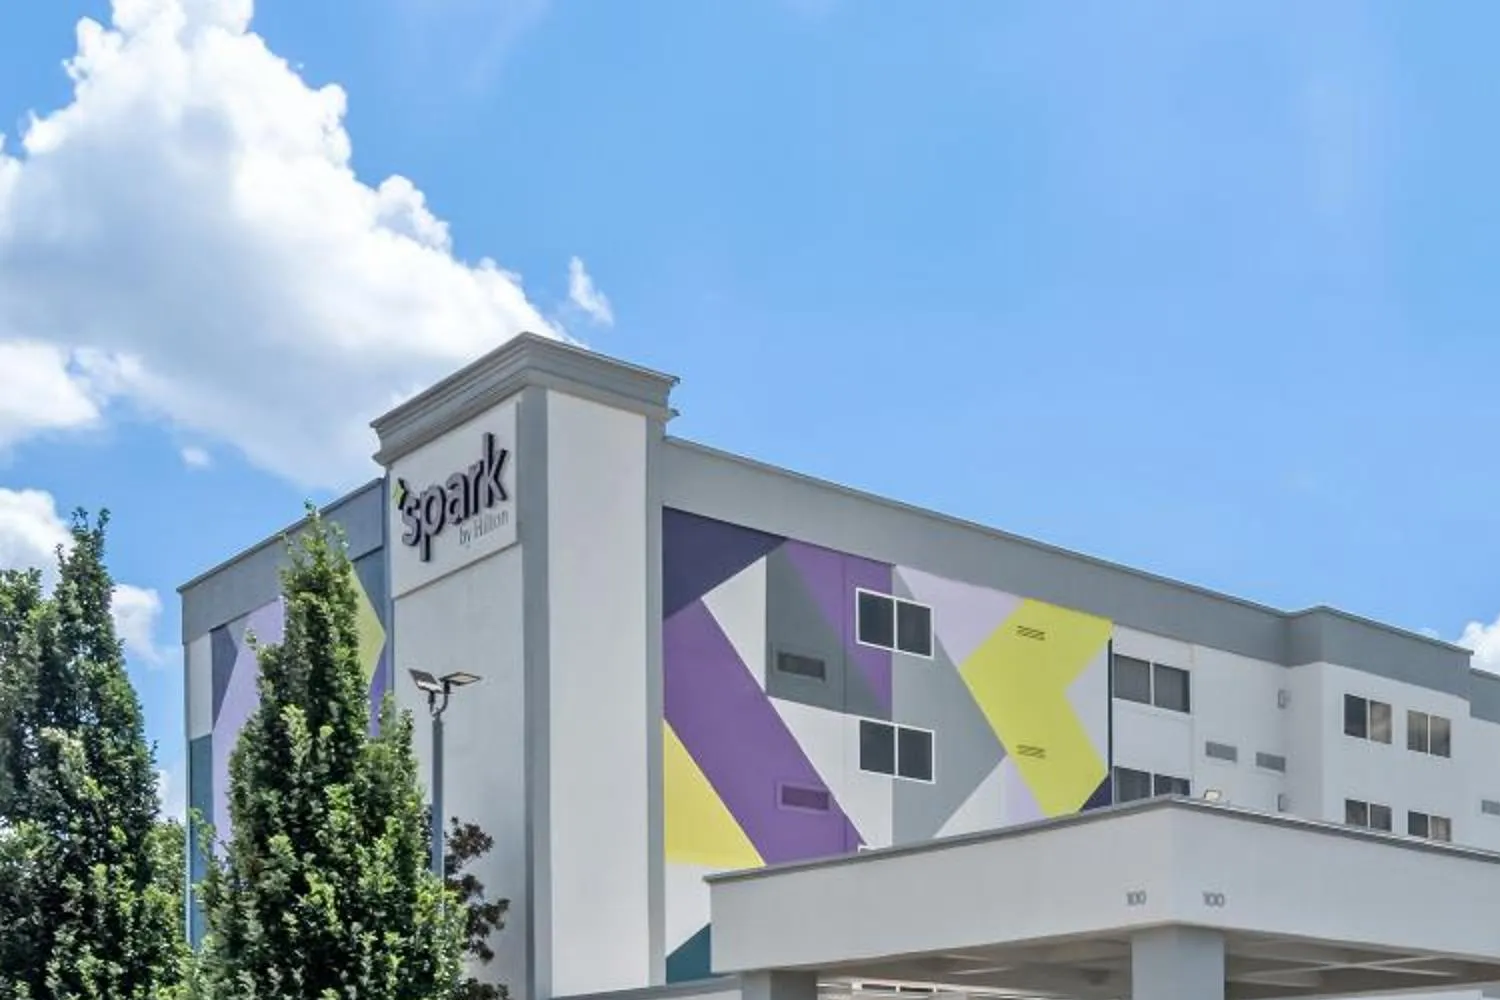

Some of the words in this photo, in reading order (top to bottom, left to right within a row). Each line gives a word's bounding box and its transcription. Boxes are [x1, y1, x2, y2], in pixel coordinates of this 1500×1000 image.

[401, 431, 508, 562] spark
[459, 525, 471, 548] by
[474, 510, 509, 537] Hilton
[1201, 891, 1225, 908] 100
